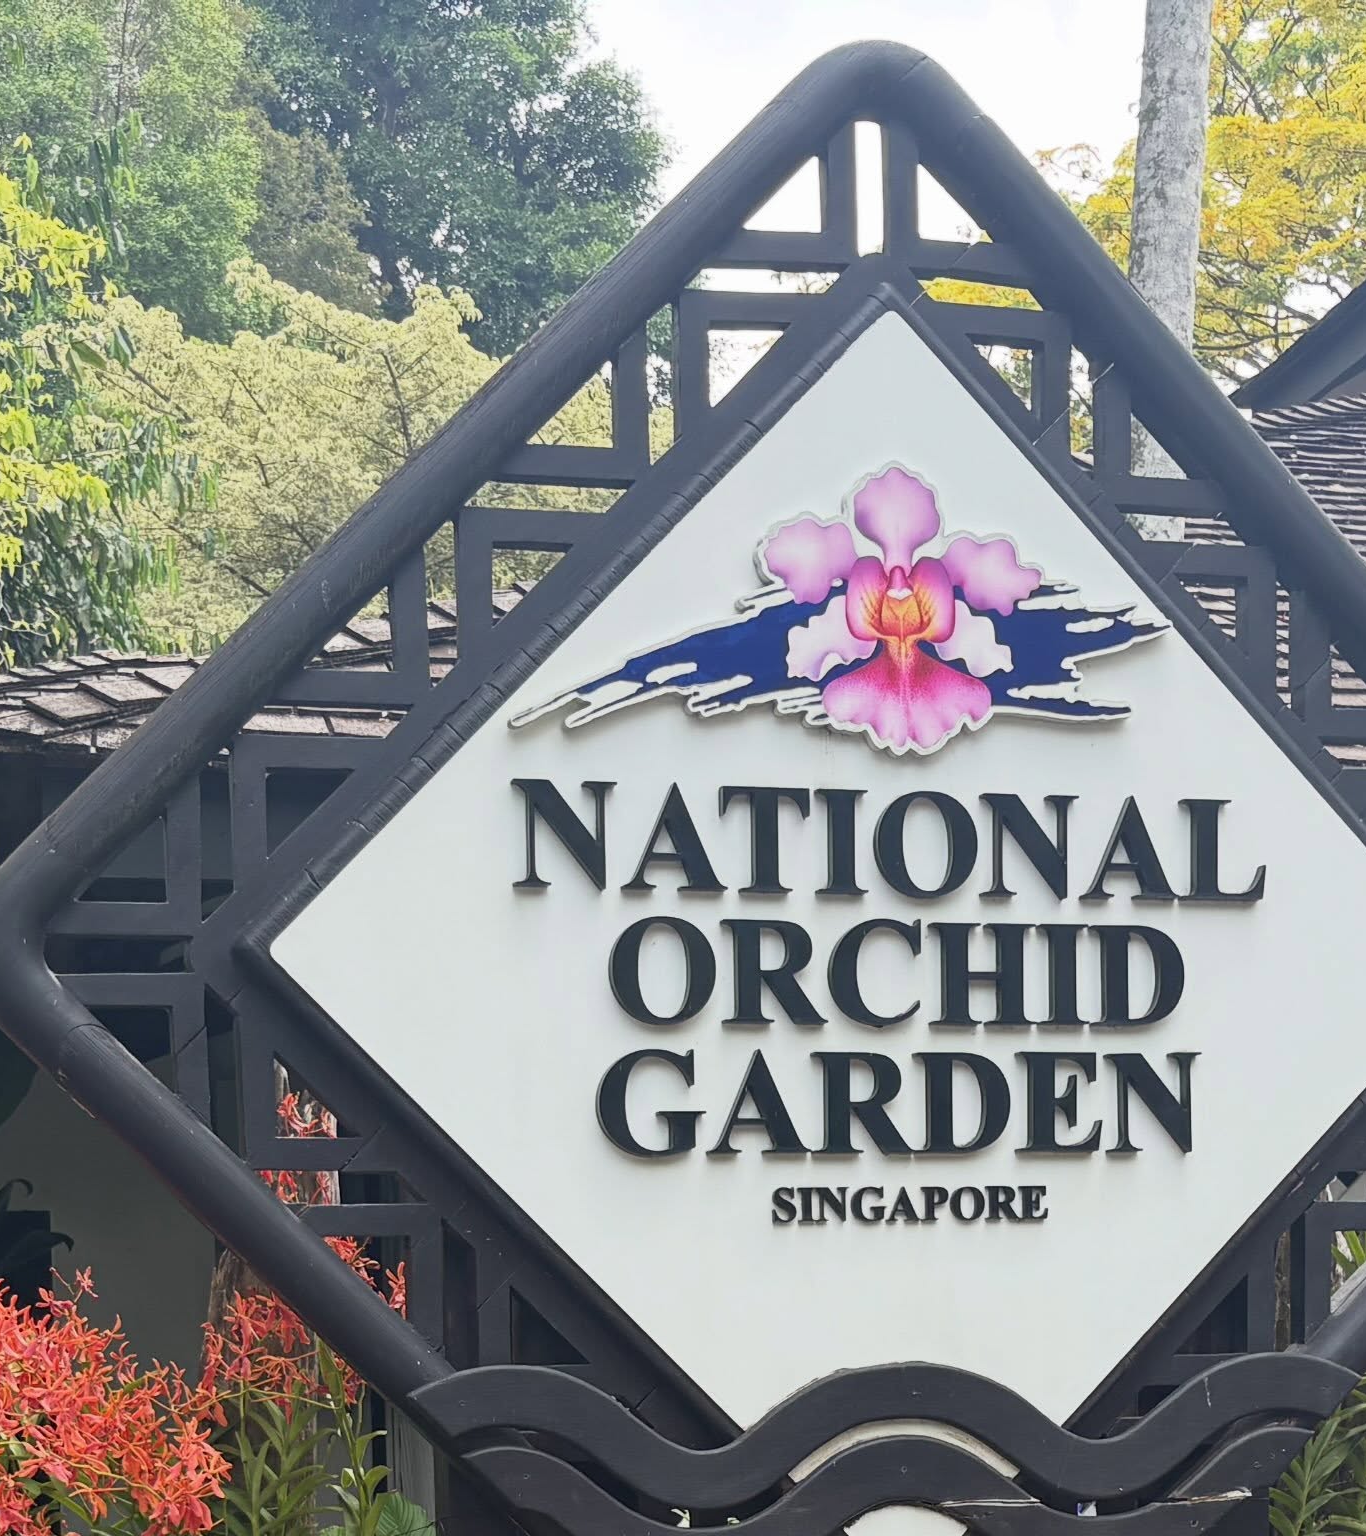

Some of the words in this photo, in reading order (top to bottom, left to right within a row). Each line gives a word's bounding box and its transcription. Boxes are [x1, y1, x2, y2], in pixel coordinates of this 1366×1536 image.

[511, 778, 1267, 902] NATIONAL
[608, 916, 1185, 1028] ORCHID
[595, 1048, 1202, 1158] GARDEN
[771, 1185, 1049, 1224] SINGAPORE
